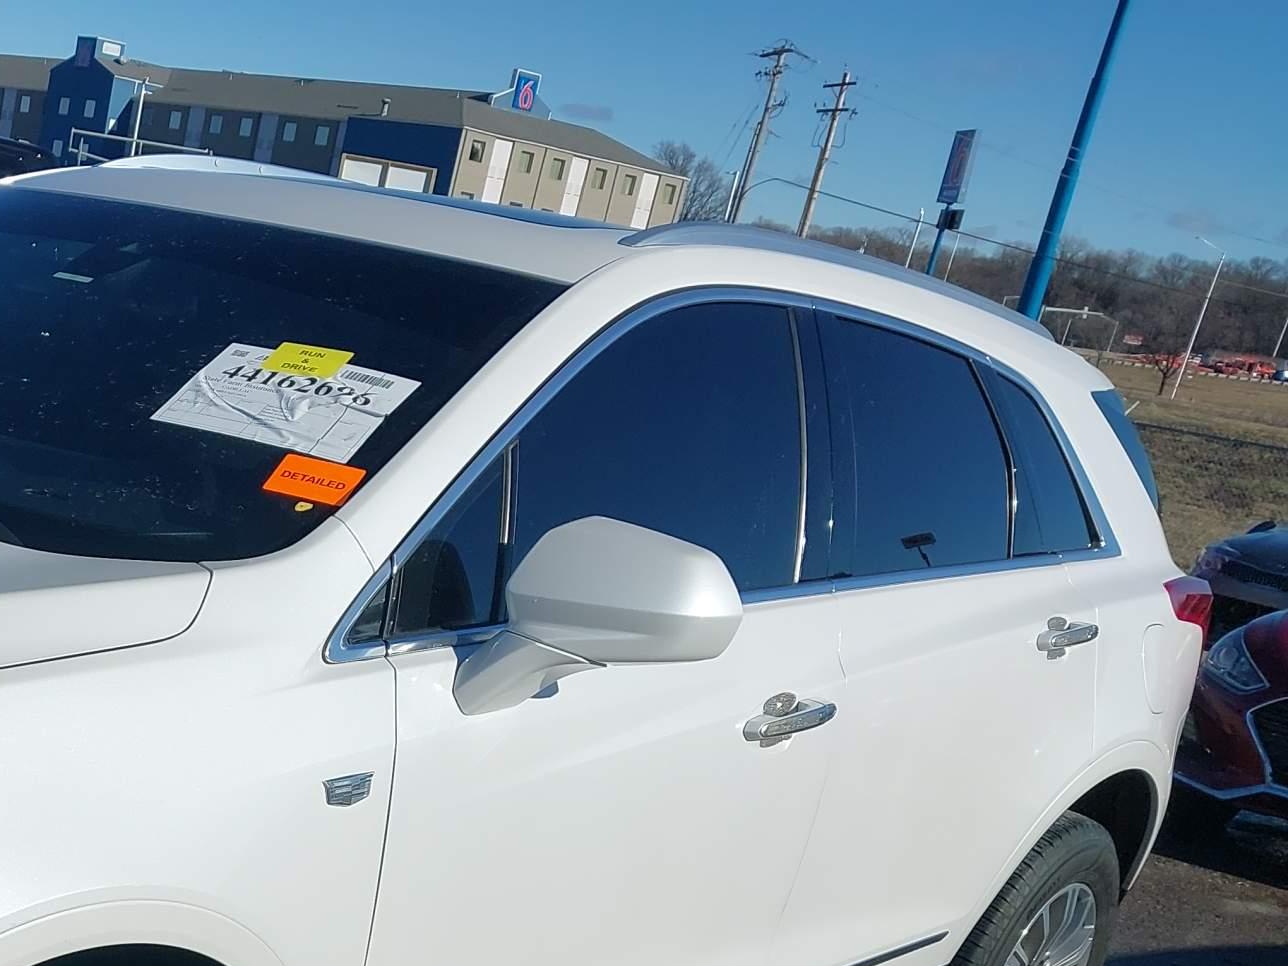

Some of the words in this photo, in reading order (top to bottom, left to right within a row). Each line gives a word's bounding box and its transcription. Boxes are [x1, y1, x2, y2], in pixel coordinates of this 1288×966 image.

[519, 80, 534, 110] 6
[298, 349, 326, 358] RUN
[281, 362, 319, 373] DRIVE
[279, 469, 347, 490] DETAILED
